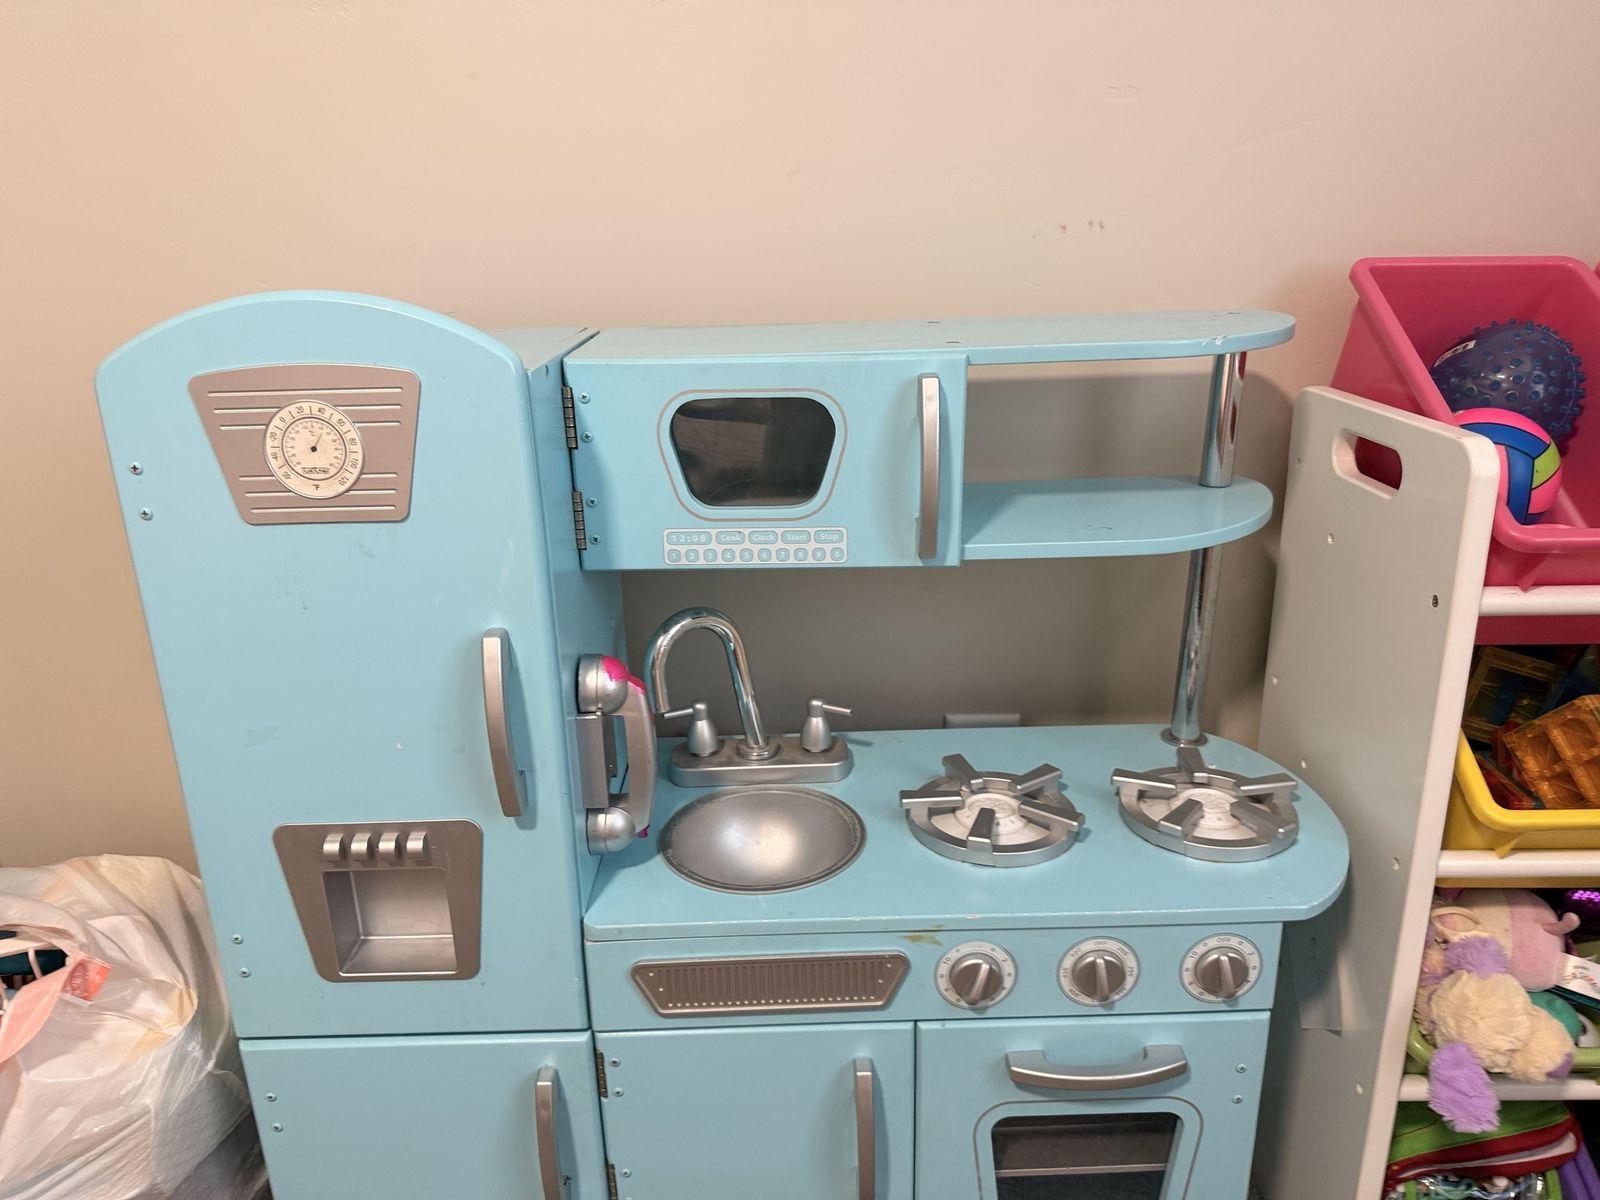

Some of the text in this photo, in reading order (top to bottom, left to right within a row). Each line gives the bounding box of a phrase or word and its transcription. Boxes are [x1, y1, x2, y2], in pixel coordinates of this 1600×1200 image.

[751, 533, 775, 541] Clock
[785, 533, 807, 541] Start
[819, 533, 840, 541] Stop
